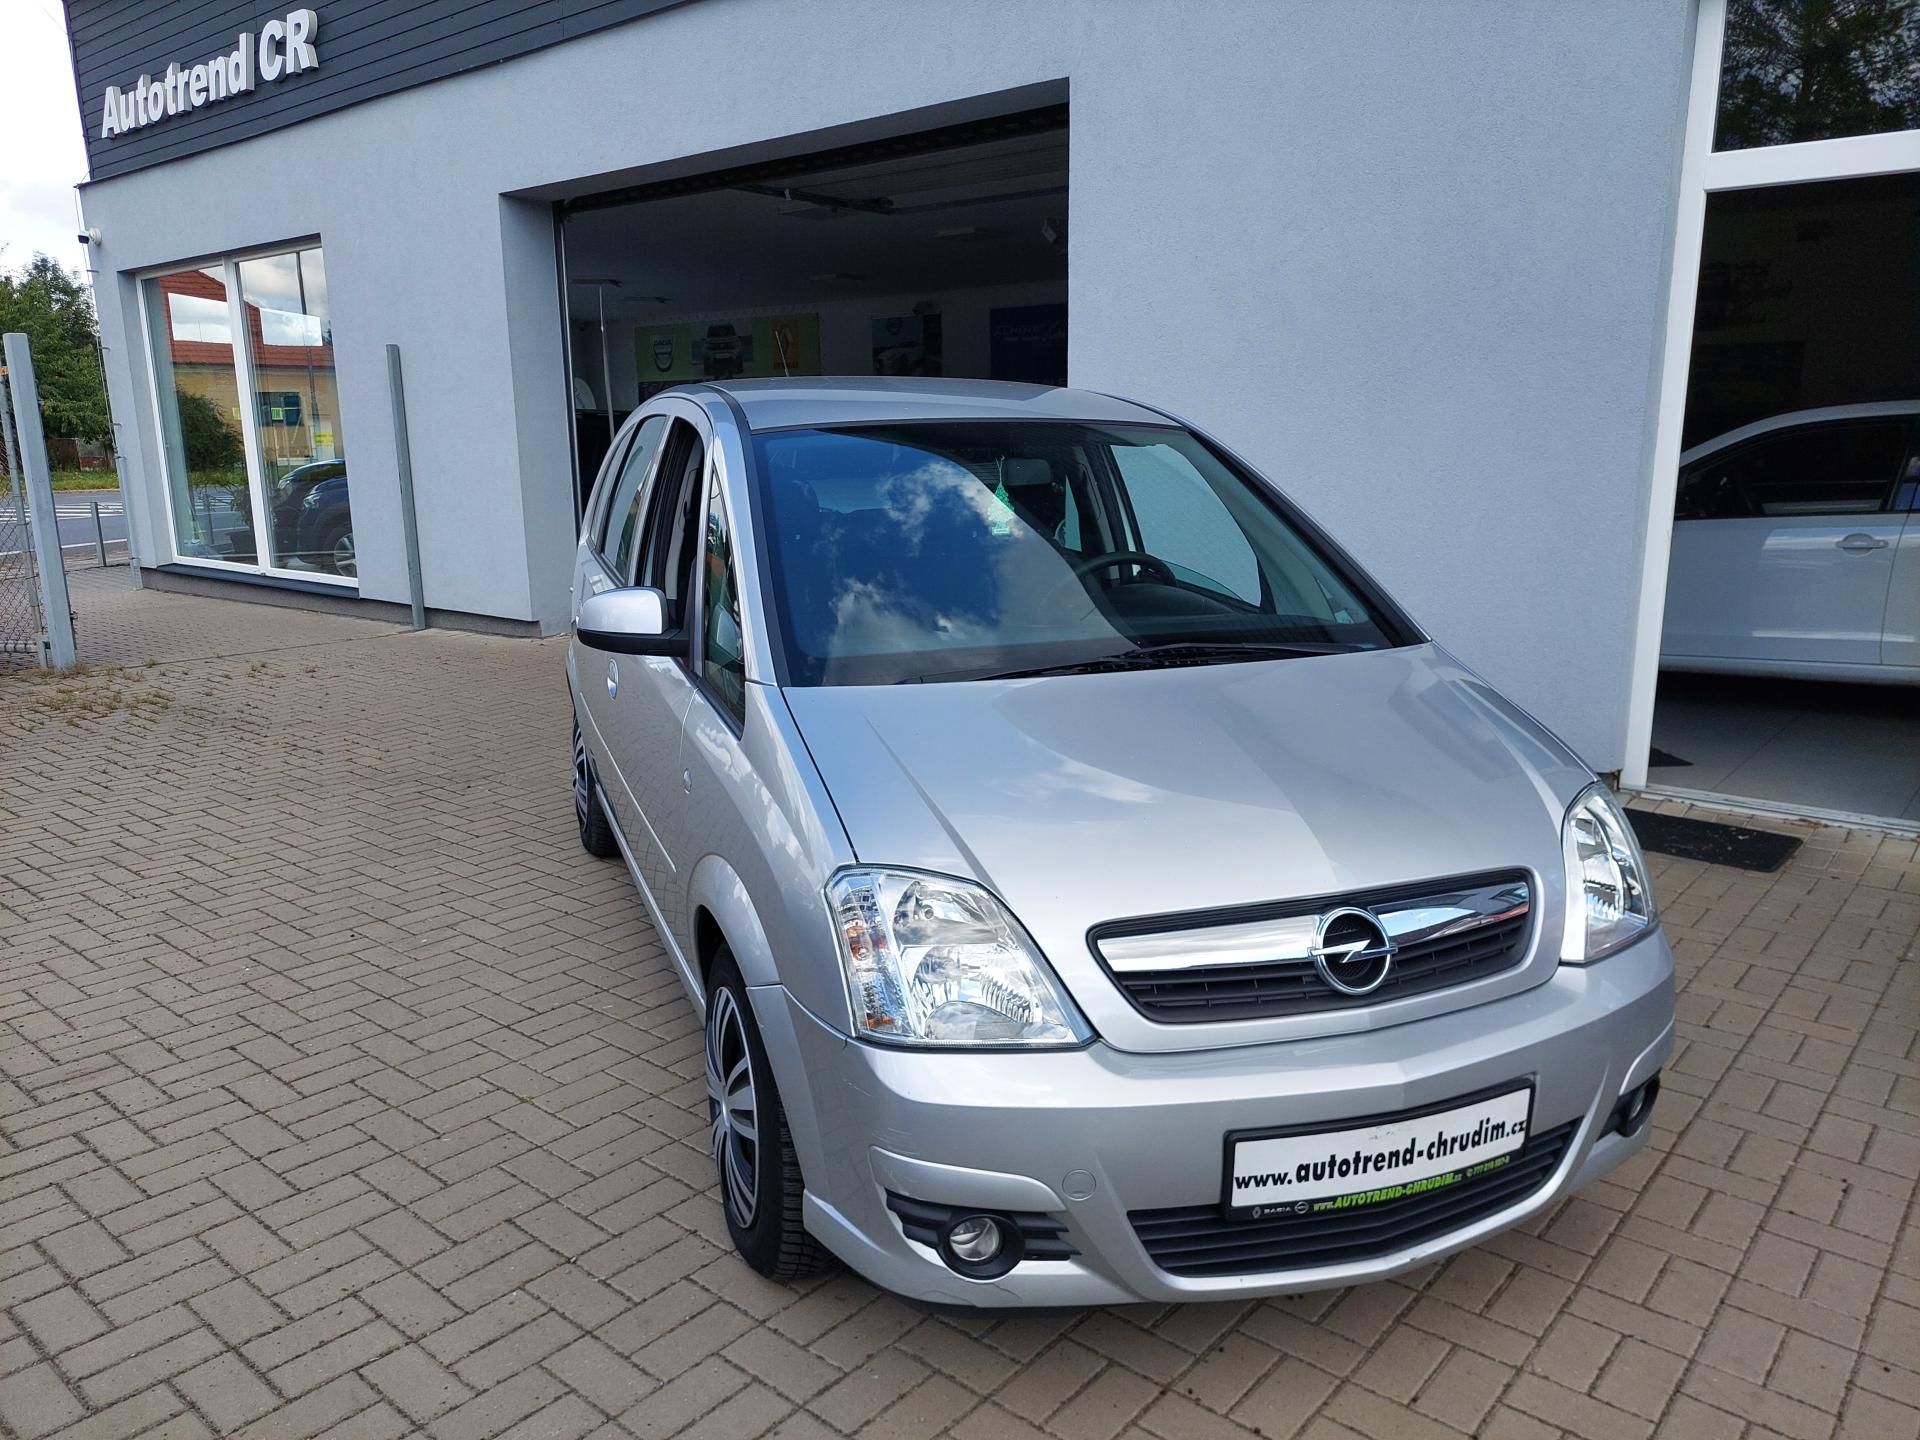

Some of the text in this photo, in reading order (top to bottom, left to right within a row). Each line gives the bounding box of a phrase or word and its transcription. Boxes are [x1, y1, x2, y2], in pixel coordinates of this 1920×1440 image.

[101, 8, 319, 139] Autotrend CR
[1234, 1117, 1527, 1189] www.autotrend-chrudim.cz
